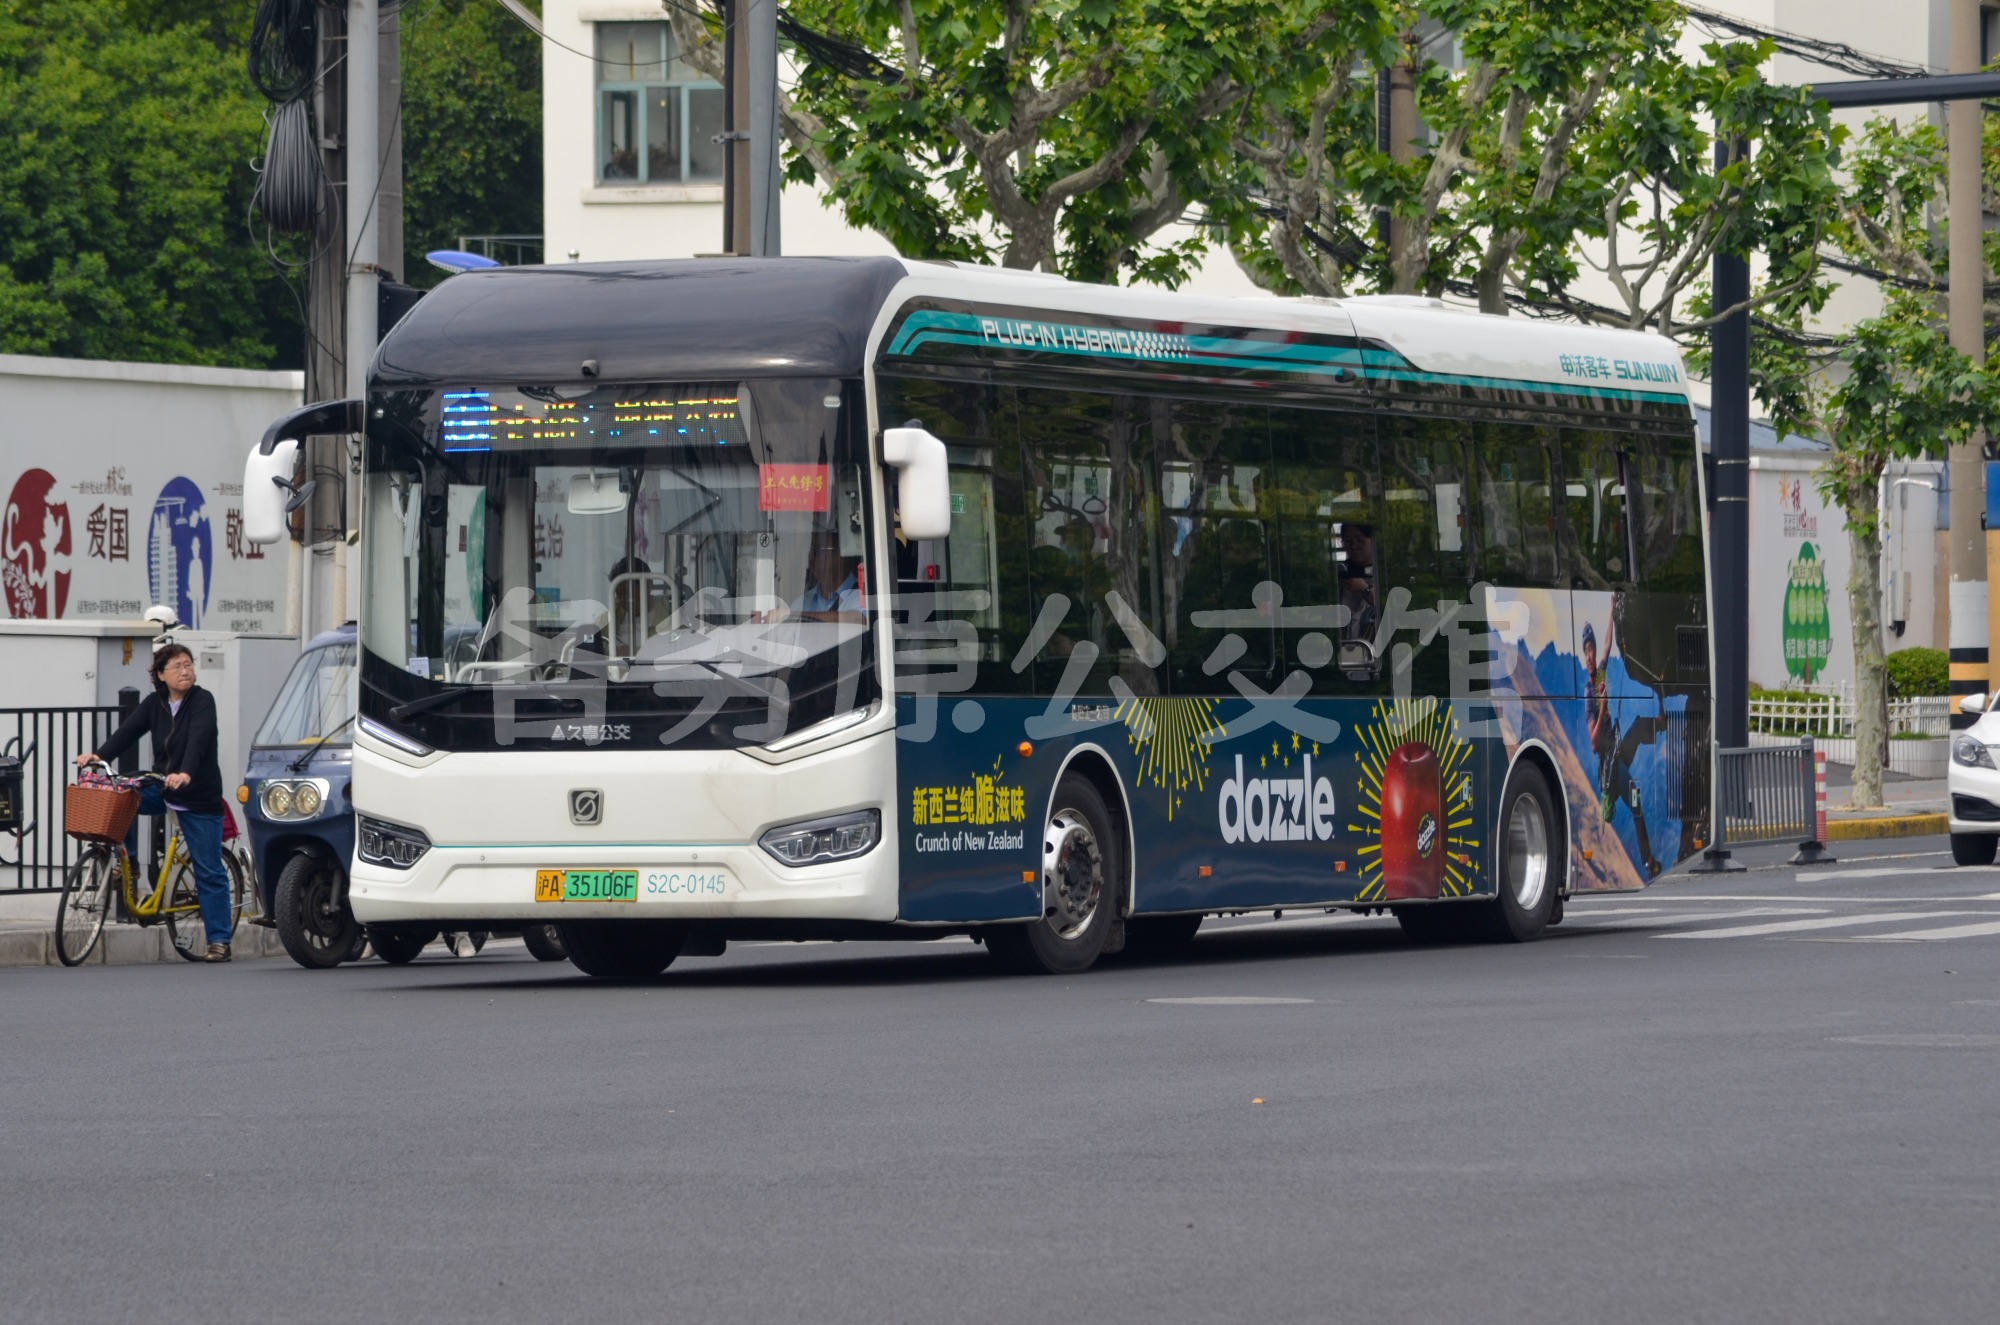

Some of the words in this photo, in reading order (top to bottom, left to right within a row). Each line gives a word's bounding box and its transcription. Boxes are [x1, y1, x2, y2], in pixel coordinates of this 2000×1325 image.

[981, 319, 1060, 349] PLUG-IN
[1062, 328, 1132, 355] HYBRID
[1559, 353, 1612, 380] 申沃客车
[1613, 359, 1679, 383] SUNWIN
[764, 475, 824, 493] 工人先锋号
[86, 503, 130, 562] 爱国
[566, 724, 631, 741] 久事公交
[912, 774, 1026, 826] 新西兰纯脆滋味
[1219, 753, 1336, 844] dazzle
[915, 831, 951, 853] Crunch
[953, 832, 965, 852] of
[965, 832, 986, 851] New
[987, 830, 1024, 850] Zealand
[538, 876, 559, 897] 沪A
[569, 874, 636, 898] 35106F
[647, 873, 726, 895] S2C-0145
